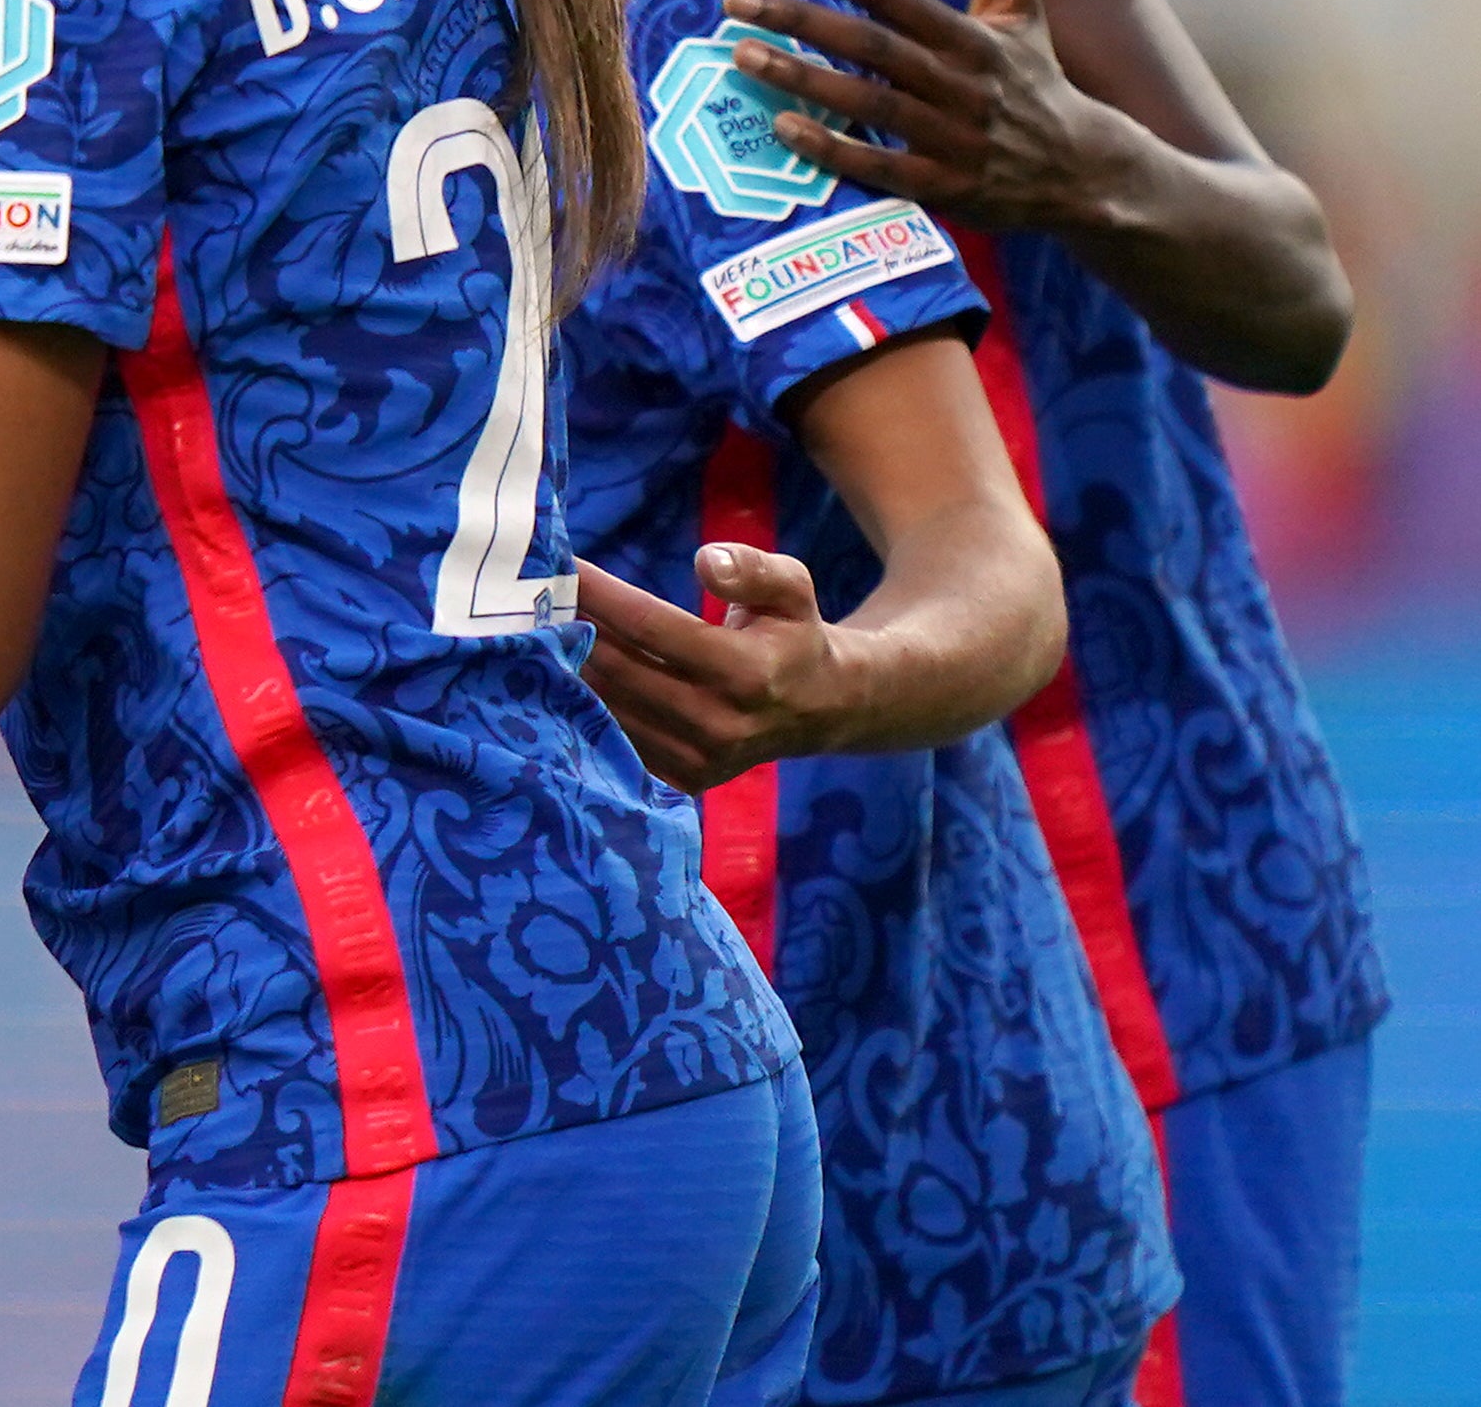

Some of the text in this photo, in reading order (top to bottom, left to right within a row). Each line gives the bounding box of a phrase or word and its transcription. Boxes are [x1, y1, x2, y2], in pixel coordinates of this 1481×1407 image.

[705, 97, 742, 114] We
[713, 255, 763, 290] UEFA
[721, 216, 934, 315] FOUNDATION
